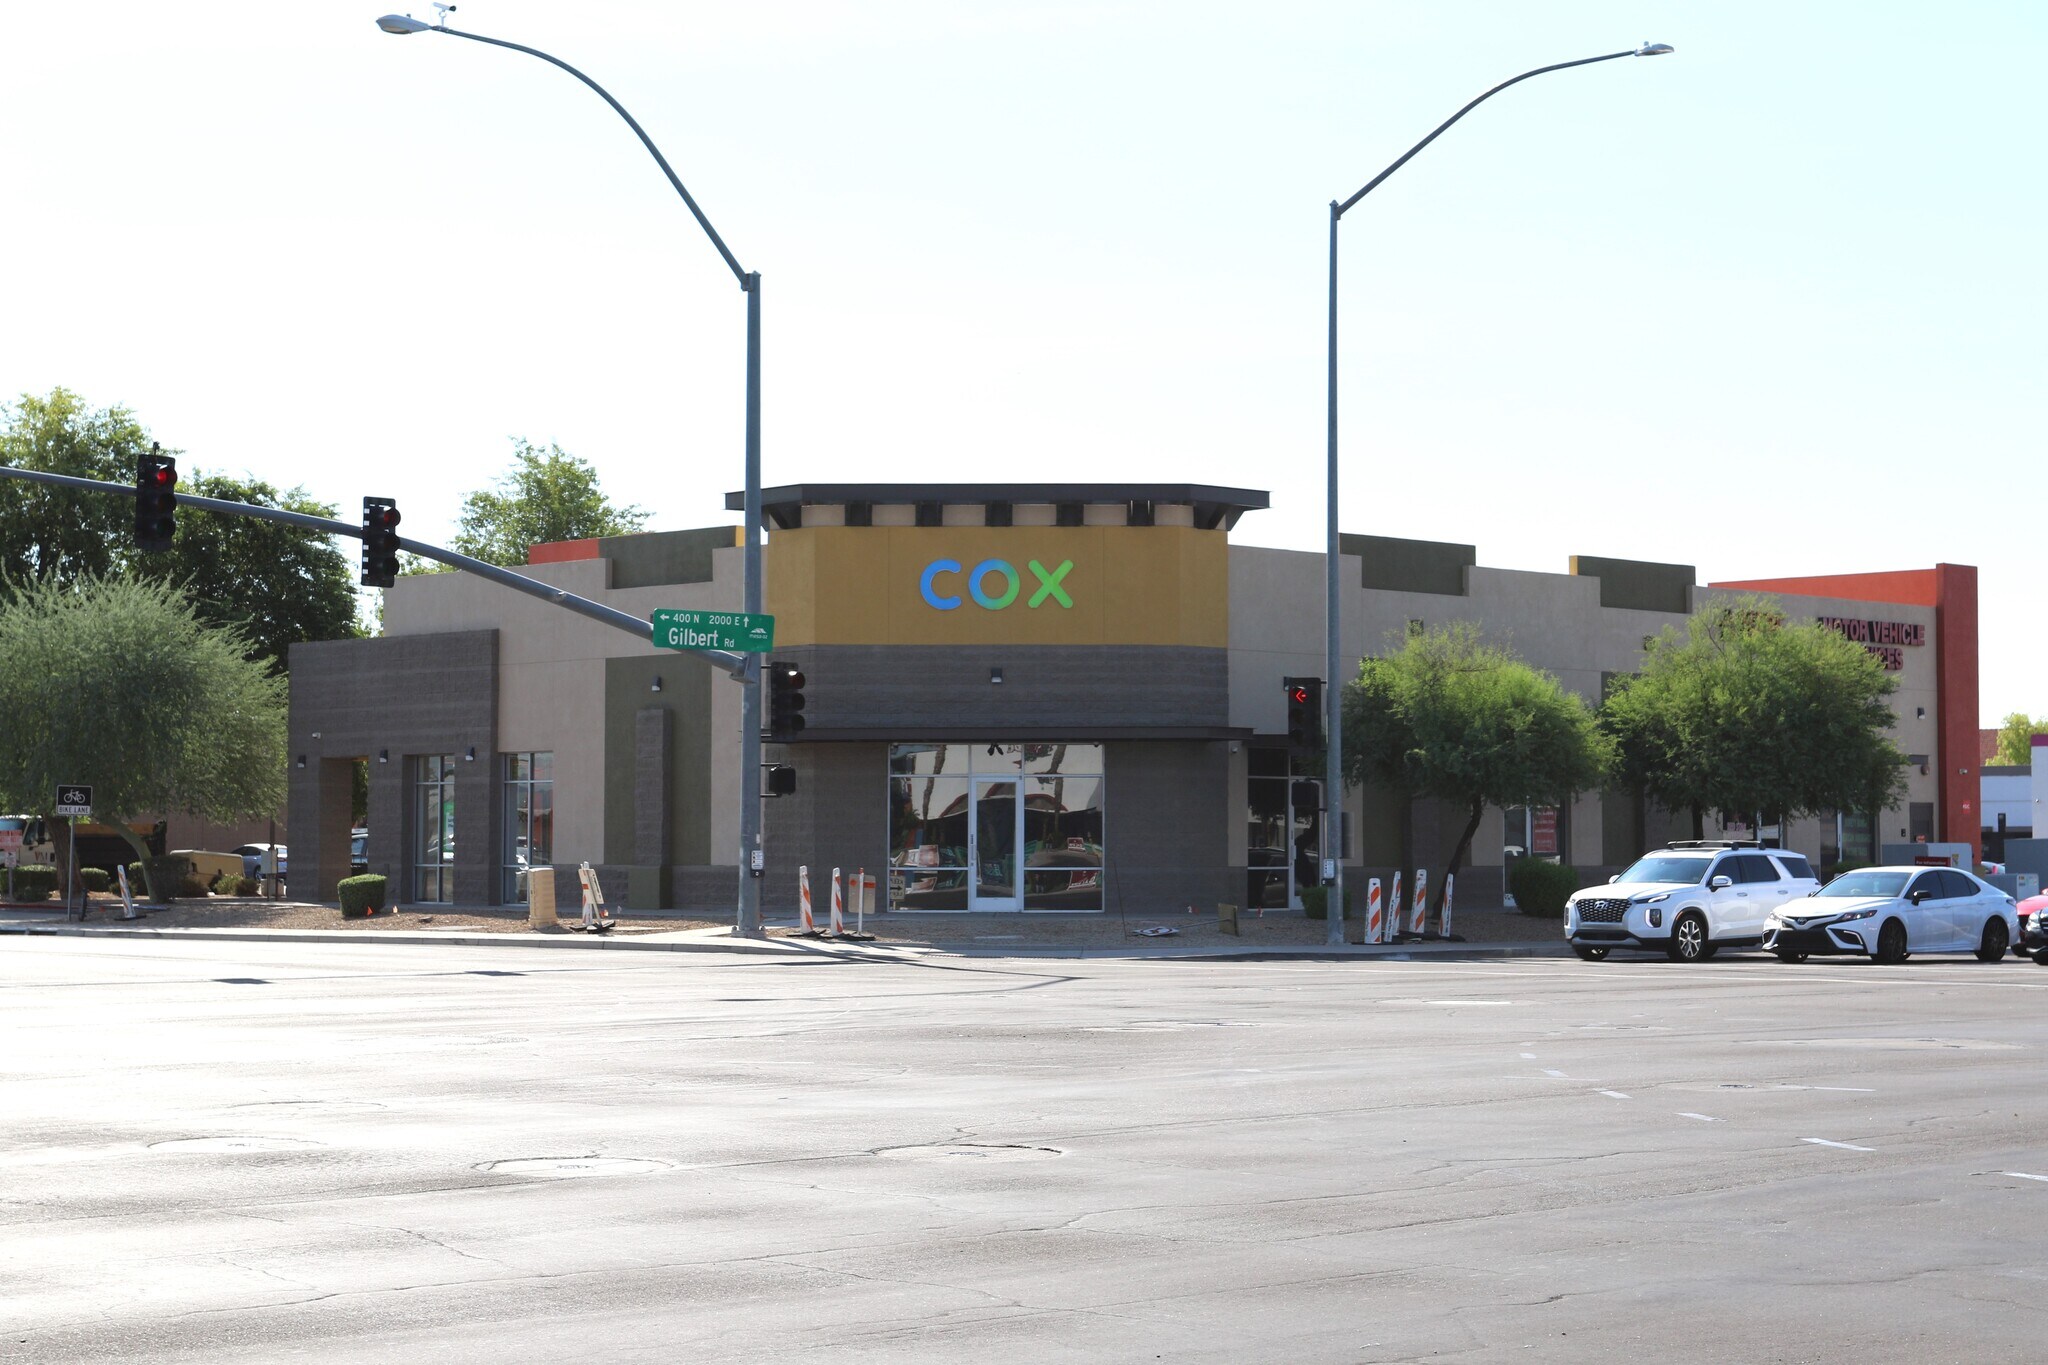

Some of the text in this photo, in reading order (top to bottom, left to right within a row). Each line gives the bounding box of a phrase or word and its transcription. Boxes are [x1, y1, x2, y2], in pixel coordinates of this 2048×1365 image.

[919, 558, 1074, 611] COX
[673, 613, 700, 623] 400 N
[709, 615, 740, 626] 2000 E
[668, 627, 735, 648] Gilbert Rd
[1873, 620, 1926, 646] VEHICLE
